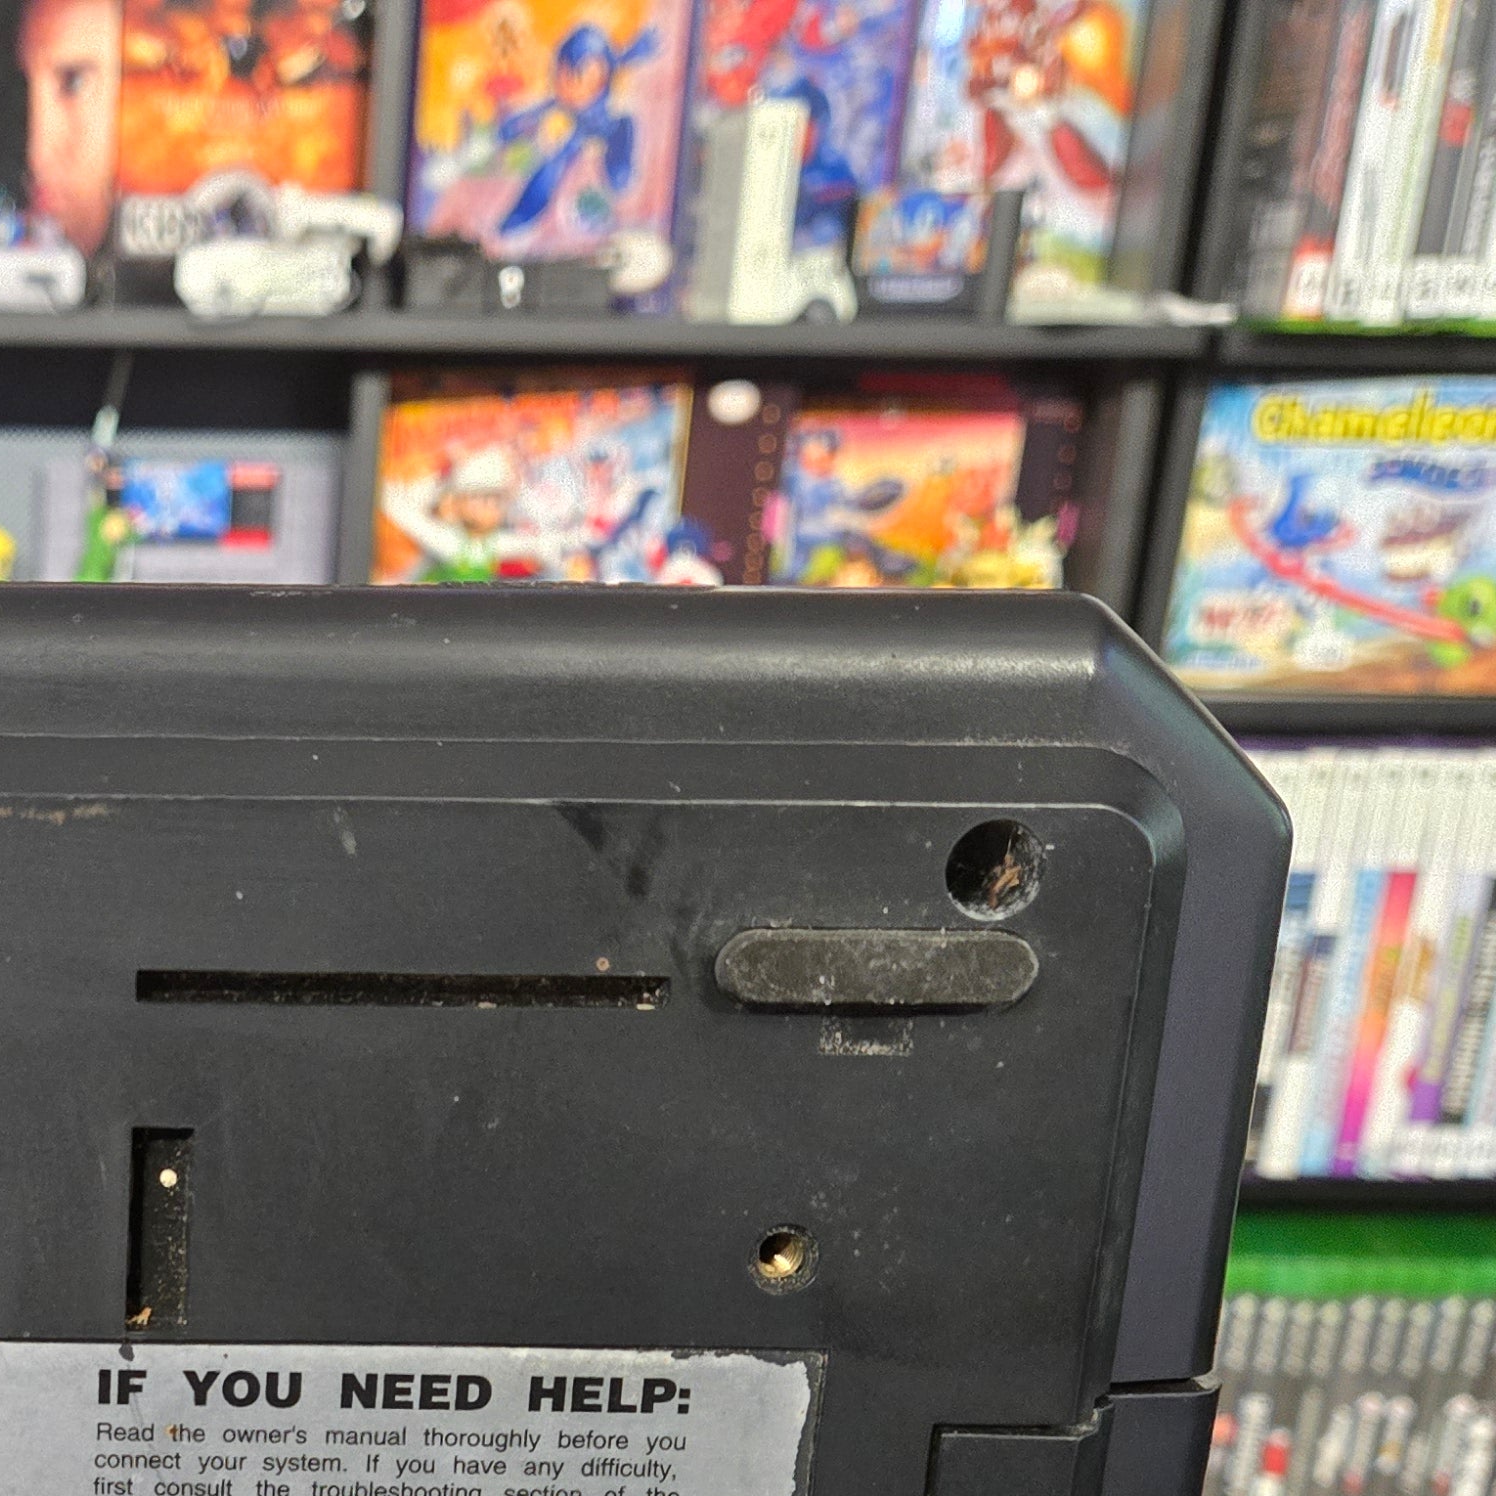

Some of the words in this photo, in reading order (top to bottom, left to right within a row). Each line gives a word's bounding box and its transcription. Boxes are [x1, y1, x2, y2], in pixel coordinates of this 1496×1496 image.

[98, 1369, 147, 1405] IF
[182, 1370, 302, 1408] YOU
[340, 1373, 492, 1411] NEED
[528, 1376, 691, 1415] HELP:
[96, 1422, 154, 1442] Read
[169, 1423, 205, 1443] the
[222, 1425, 307, 1444] owner's
[325, 1426, 406, 1446] manual
[423, 1427, 541, 1453] thoroughly
[557, 1429, 629, 1450] before
[645, 1435, 686, 1456] you
[94, 1452, 181, 1470] connect
[197, 1455, 247, 1475] your
[262, 1453, 347, 1476] system.
[395, 1458, 435, 1479] you
[453, 1455, 507, 1475] have
[523, 1461, 564, 1481] any
[580, 1457, 676, 1483] difficulty,
[93, 1476, 133, 1496] first
[154, 1478, 233, 1496] consult
